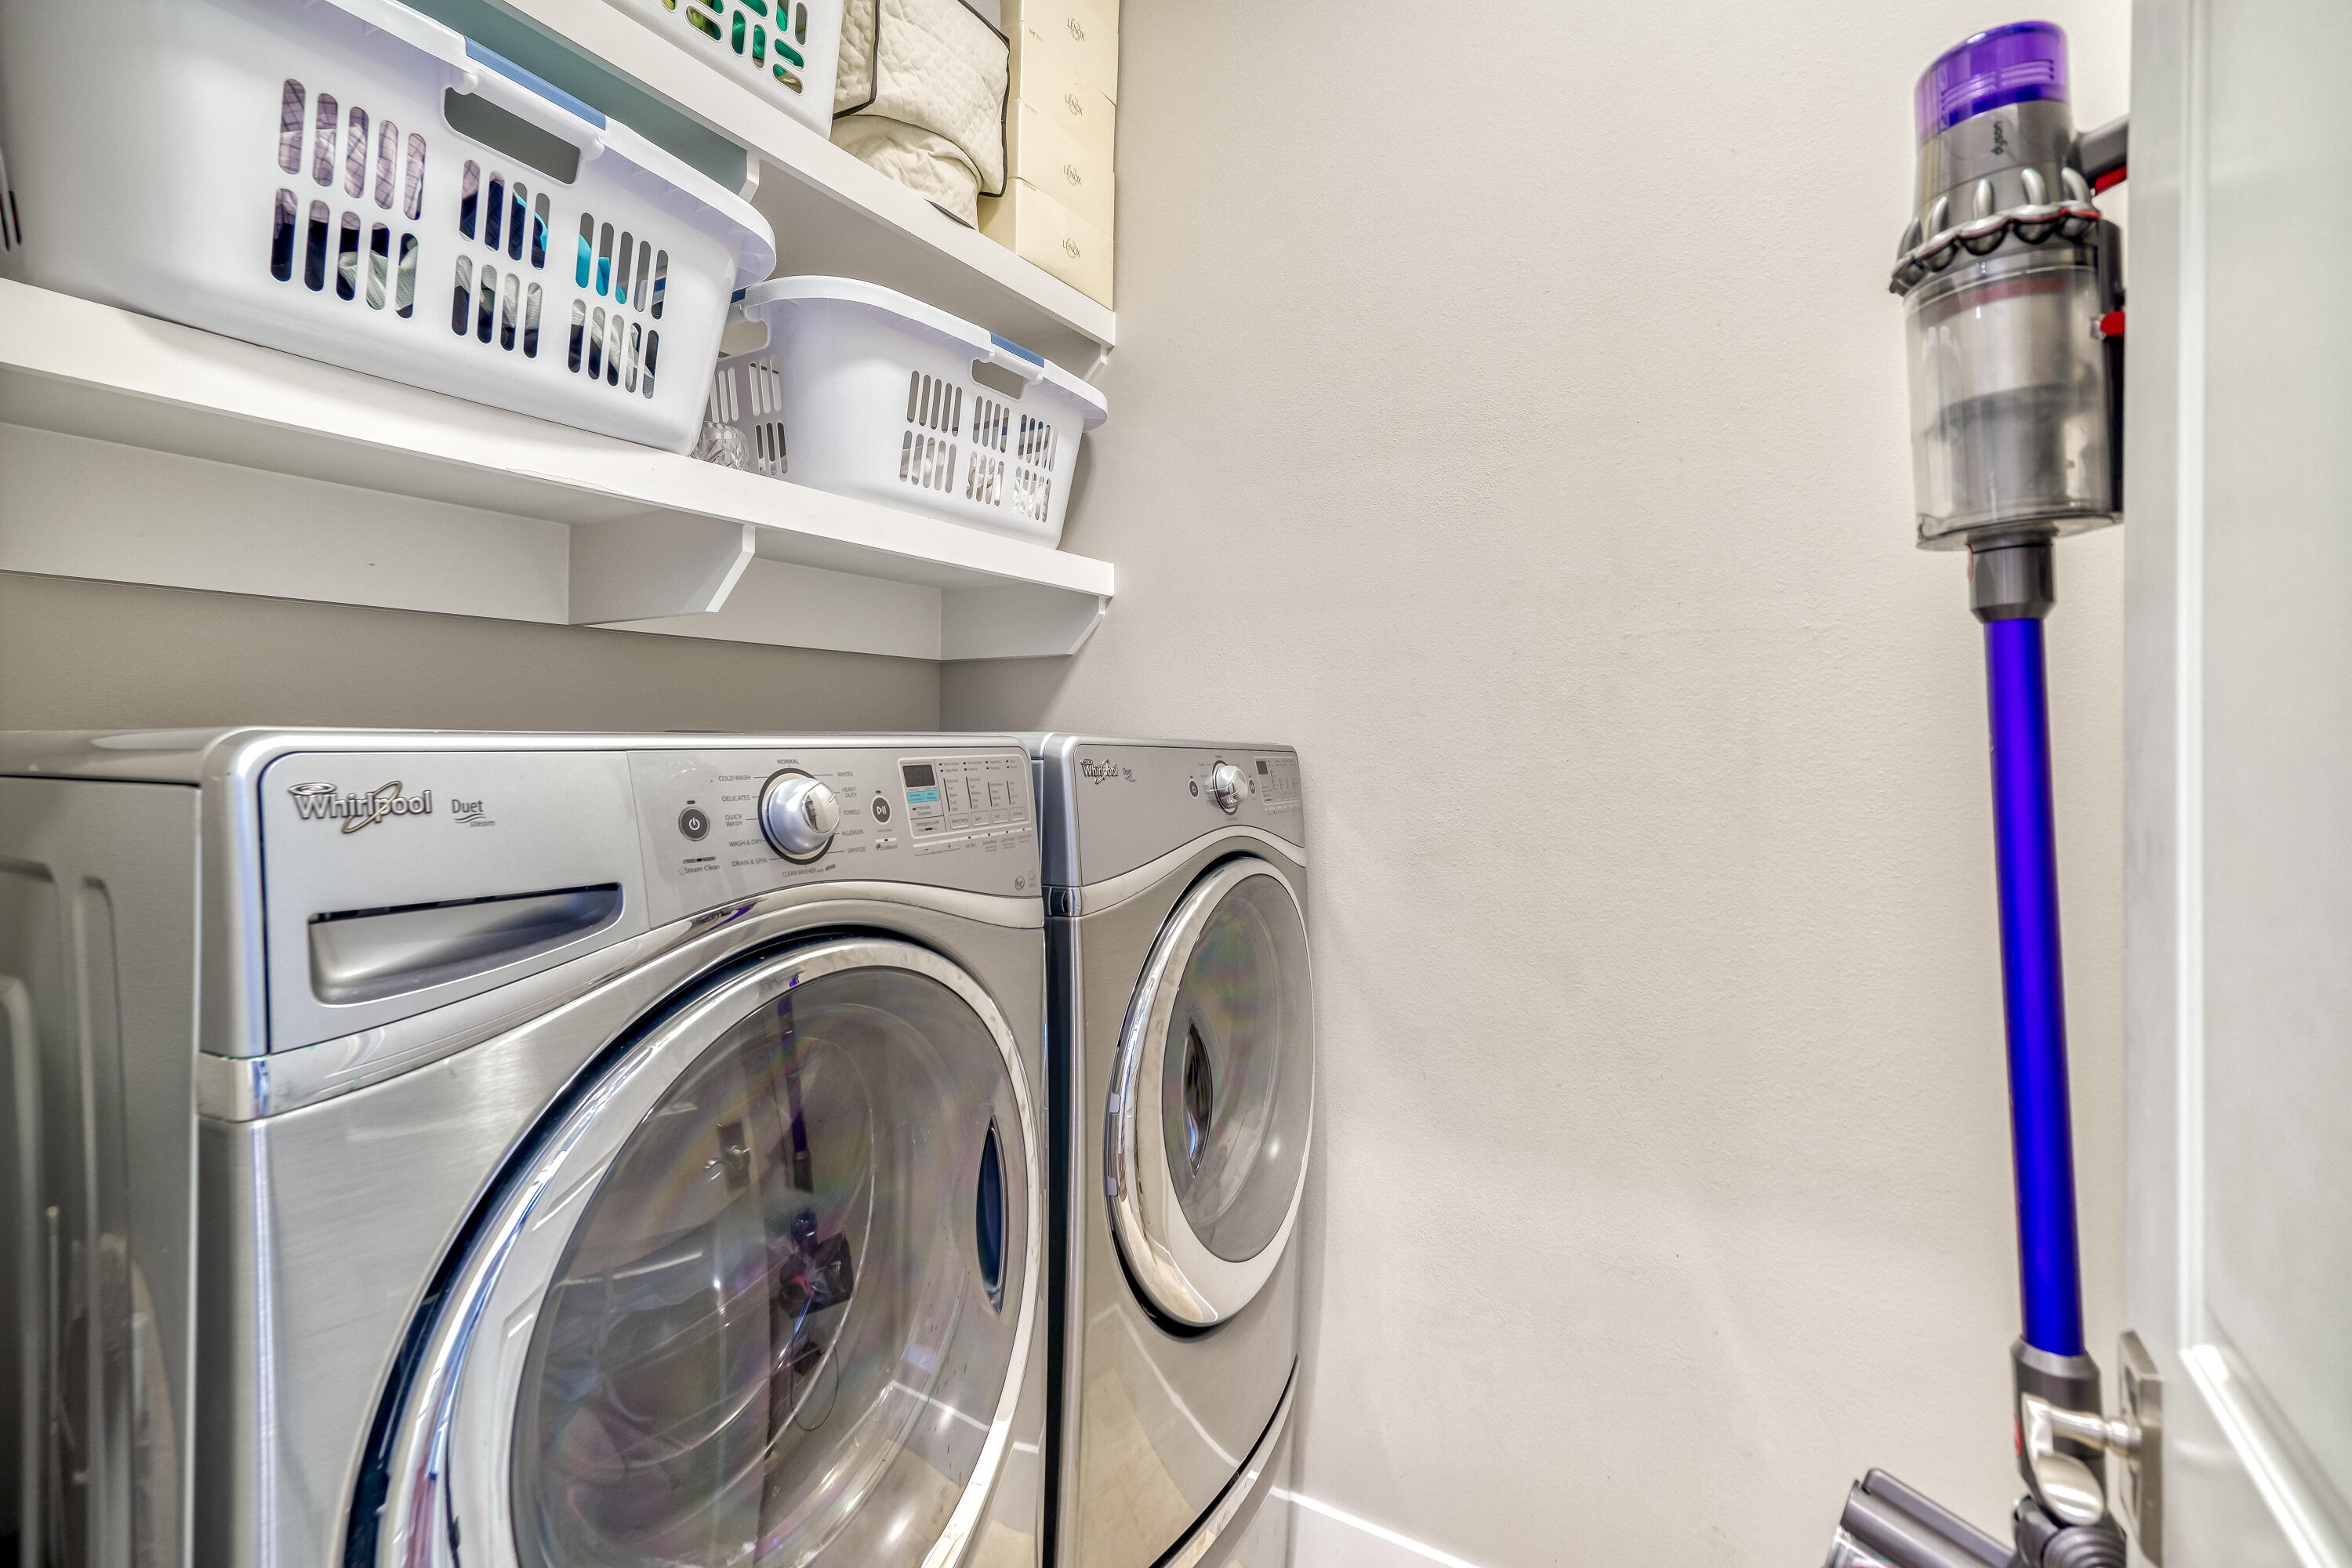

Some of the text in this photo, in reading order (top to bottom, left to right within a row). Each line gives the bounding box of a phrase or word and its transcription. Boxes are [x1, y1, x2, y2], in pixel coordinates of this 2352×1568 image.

[1067, 18, 1084, 42] LENOX
[1065, 94, 1083, 116] LENOX
[1991, 121, 2008, 155] dyson
[1063, 165, 1081, 185] LENOX
[1062, 239, 1080, 258] LENOX
[1081, 764, 1118, 780] Whirlpool
[293, 788, 432, 824] Whirlpool
[452, 798, 483, 813] Duet
